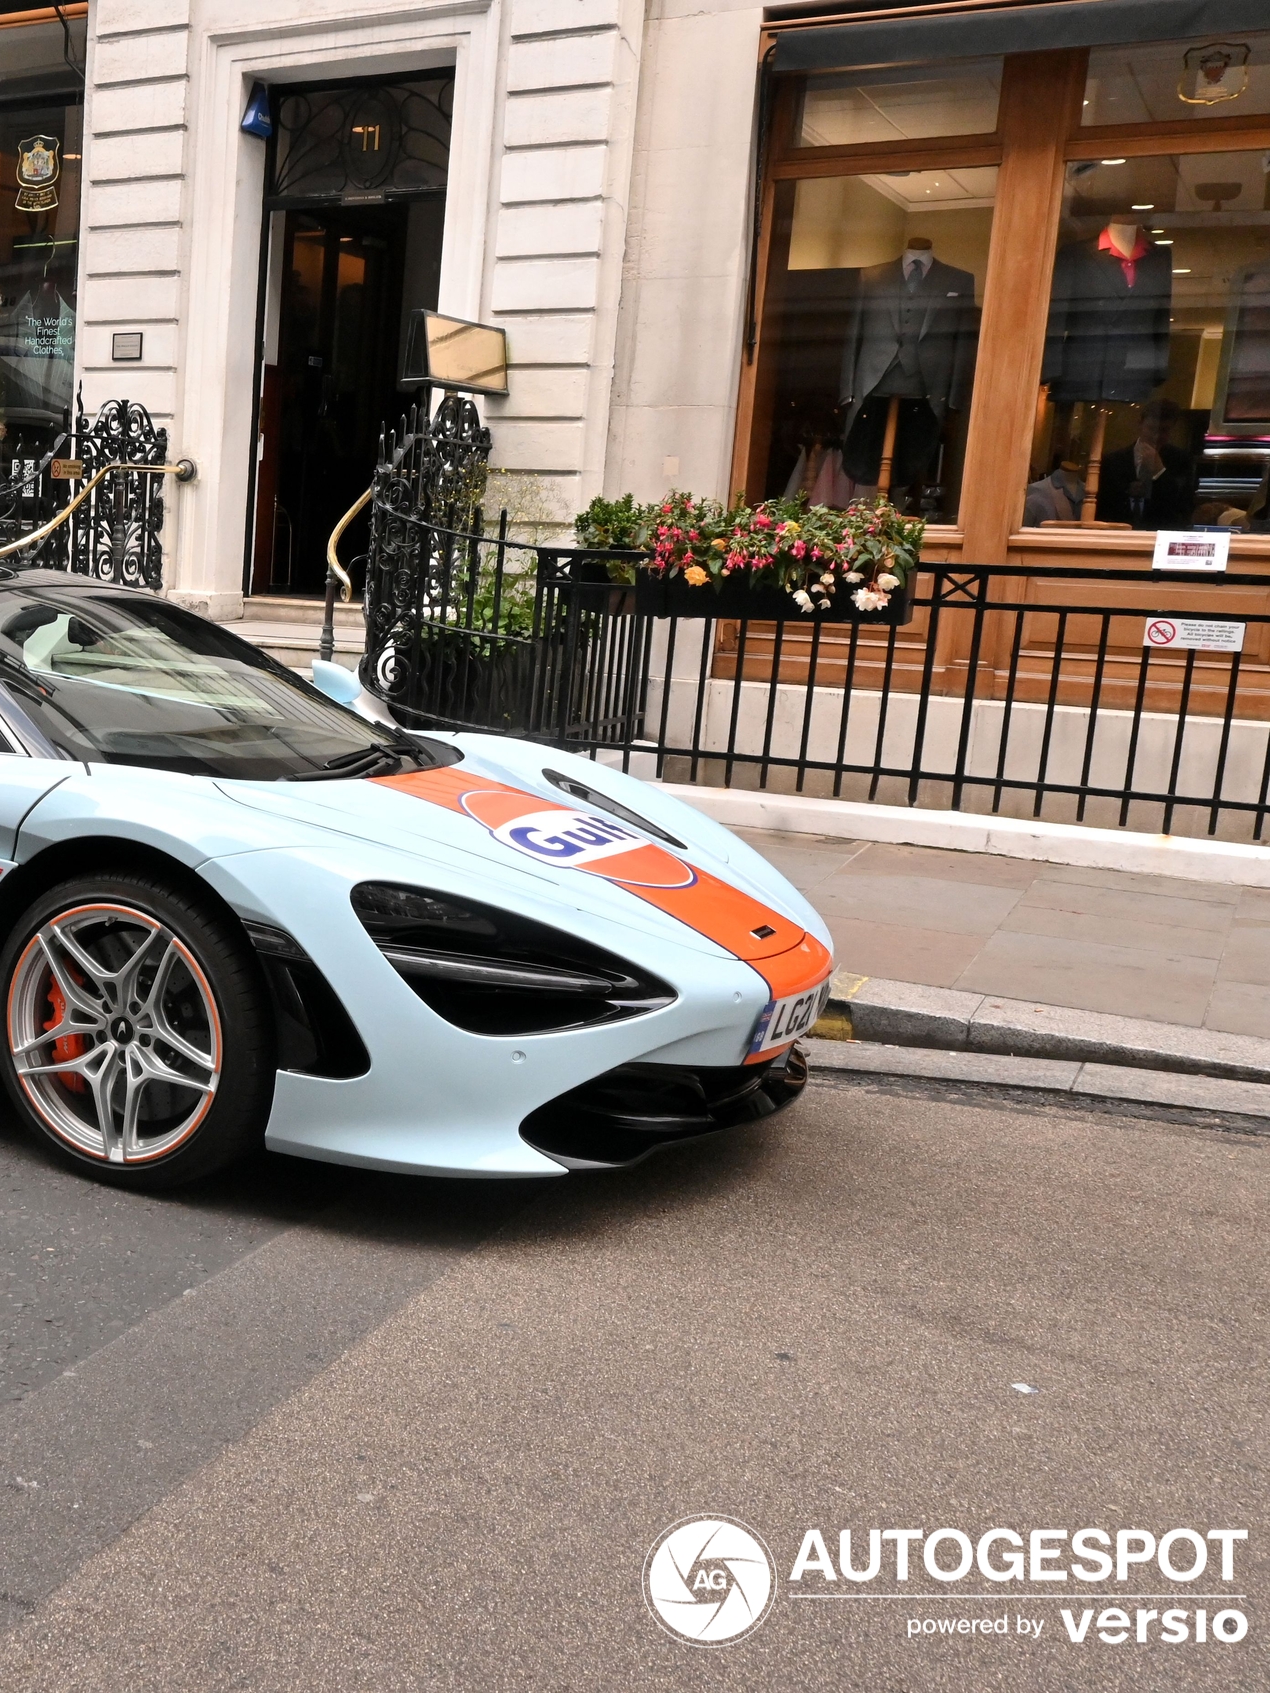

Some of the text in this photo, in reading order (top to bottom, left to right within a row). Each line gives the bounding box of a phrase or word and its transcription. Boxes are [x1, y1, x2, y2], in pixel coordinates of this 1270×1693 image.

[362, 125, 380, 151] 11
[43, 316, 73, 326] World's
[36, 326, 61, 336] Finest
[24, 335, 73, 346] Handcrafted
[509, 816, 641, 858] Gulf
